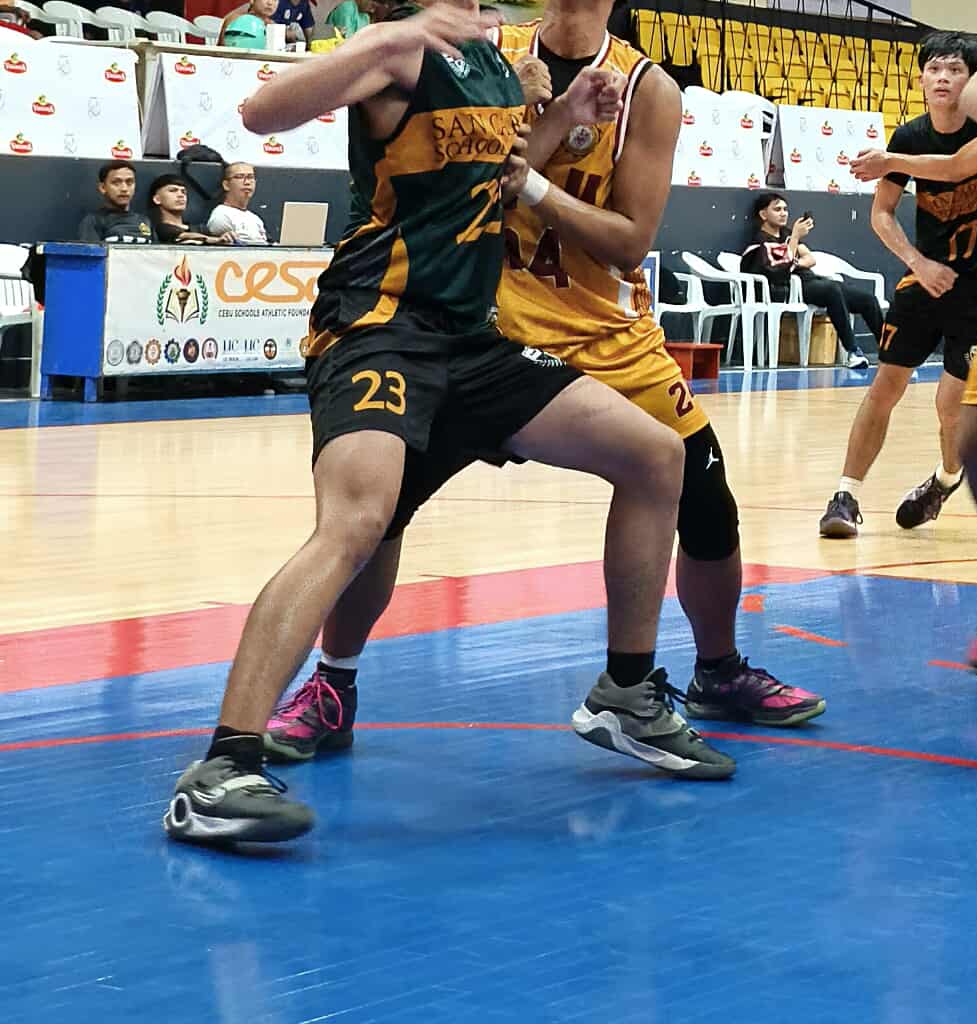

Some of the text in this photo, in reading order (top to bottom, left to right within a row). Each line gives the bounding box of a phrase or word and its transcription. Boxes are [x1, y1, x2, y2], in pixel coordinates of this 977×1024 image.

[456, 178, 502, 245] 2
[352, 369, 406, 416] 23
[668, 381, 694, 418] 2
